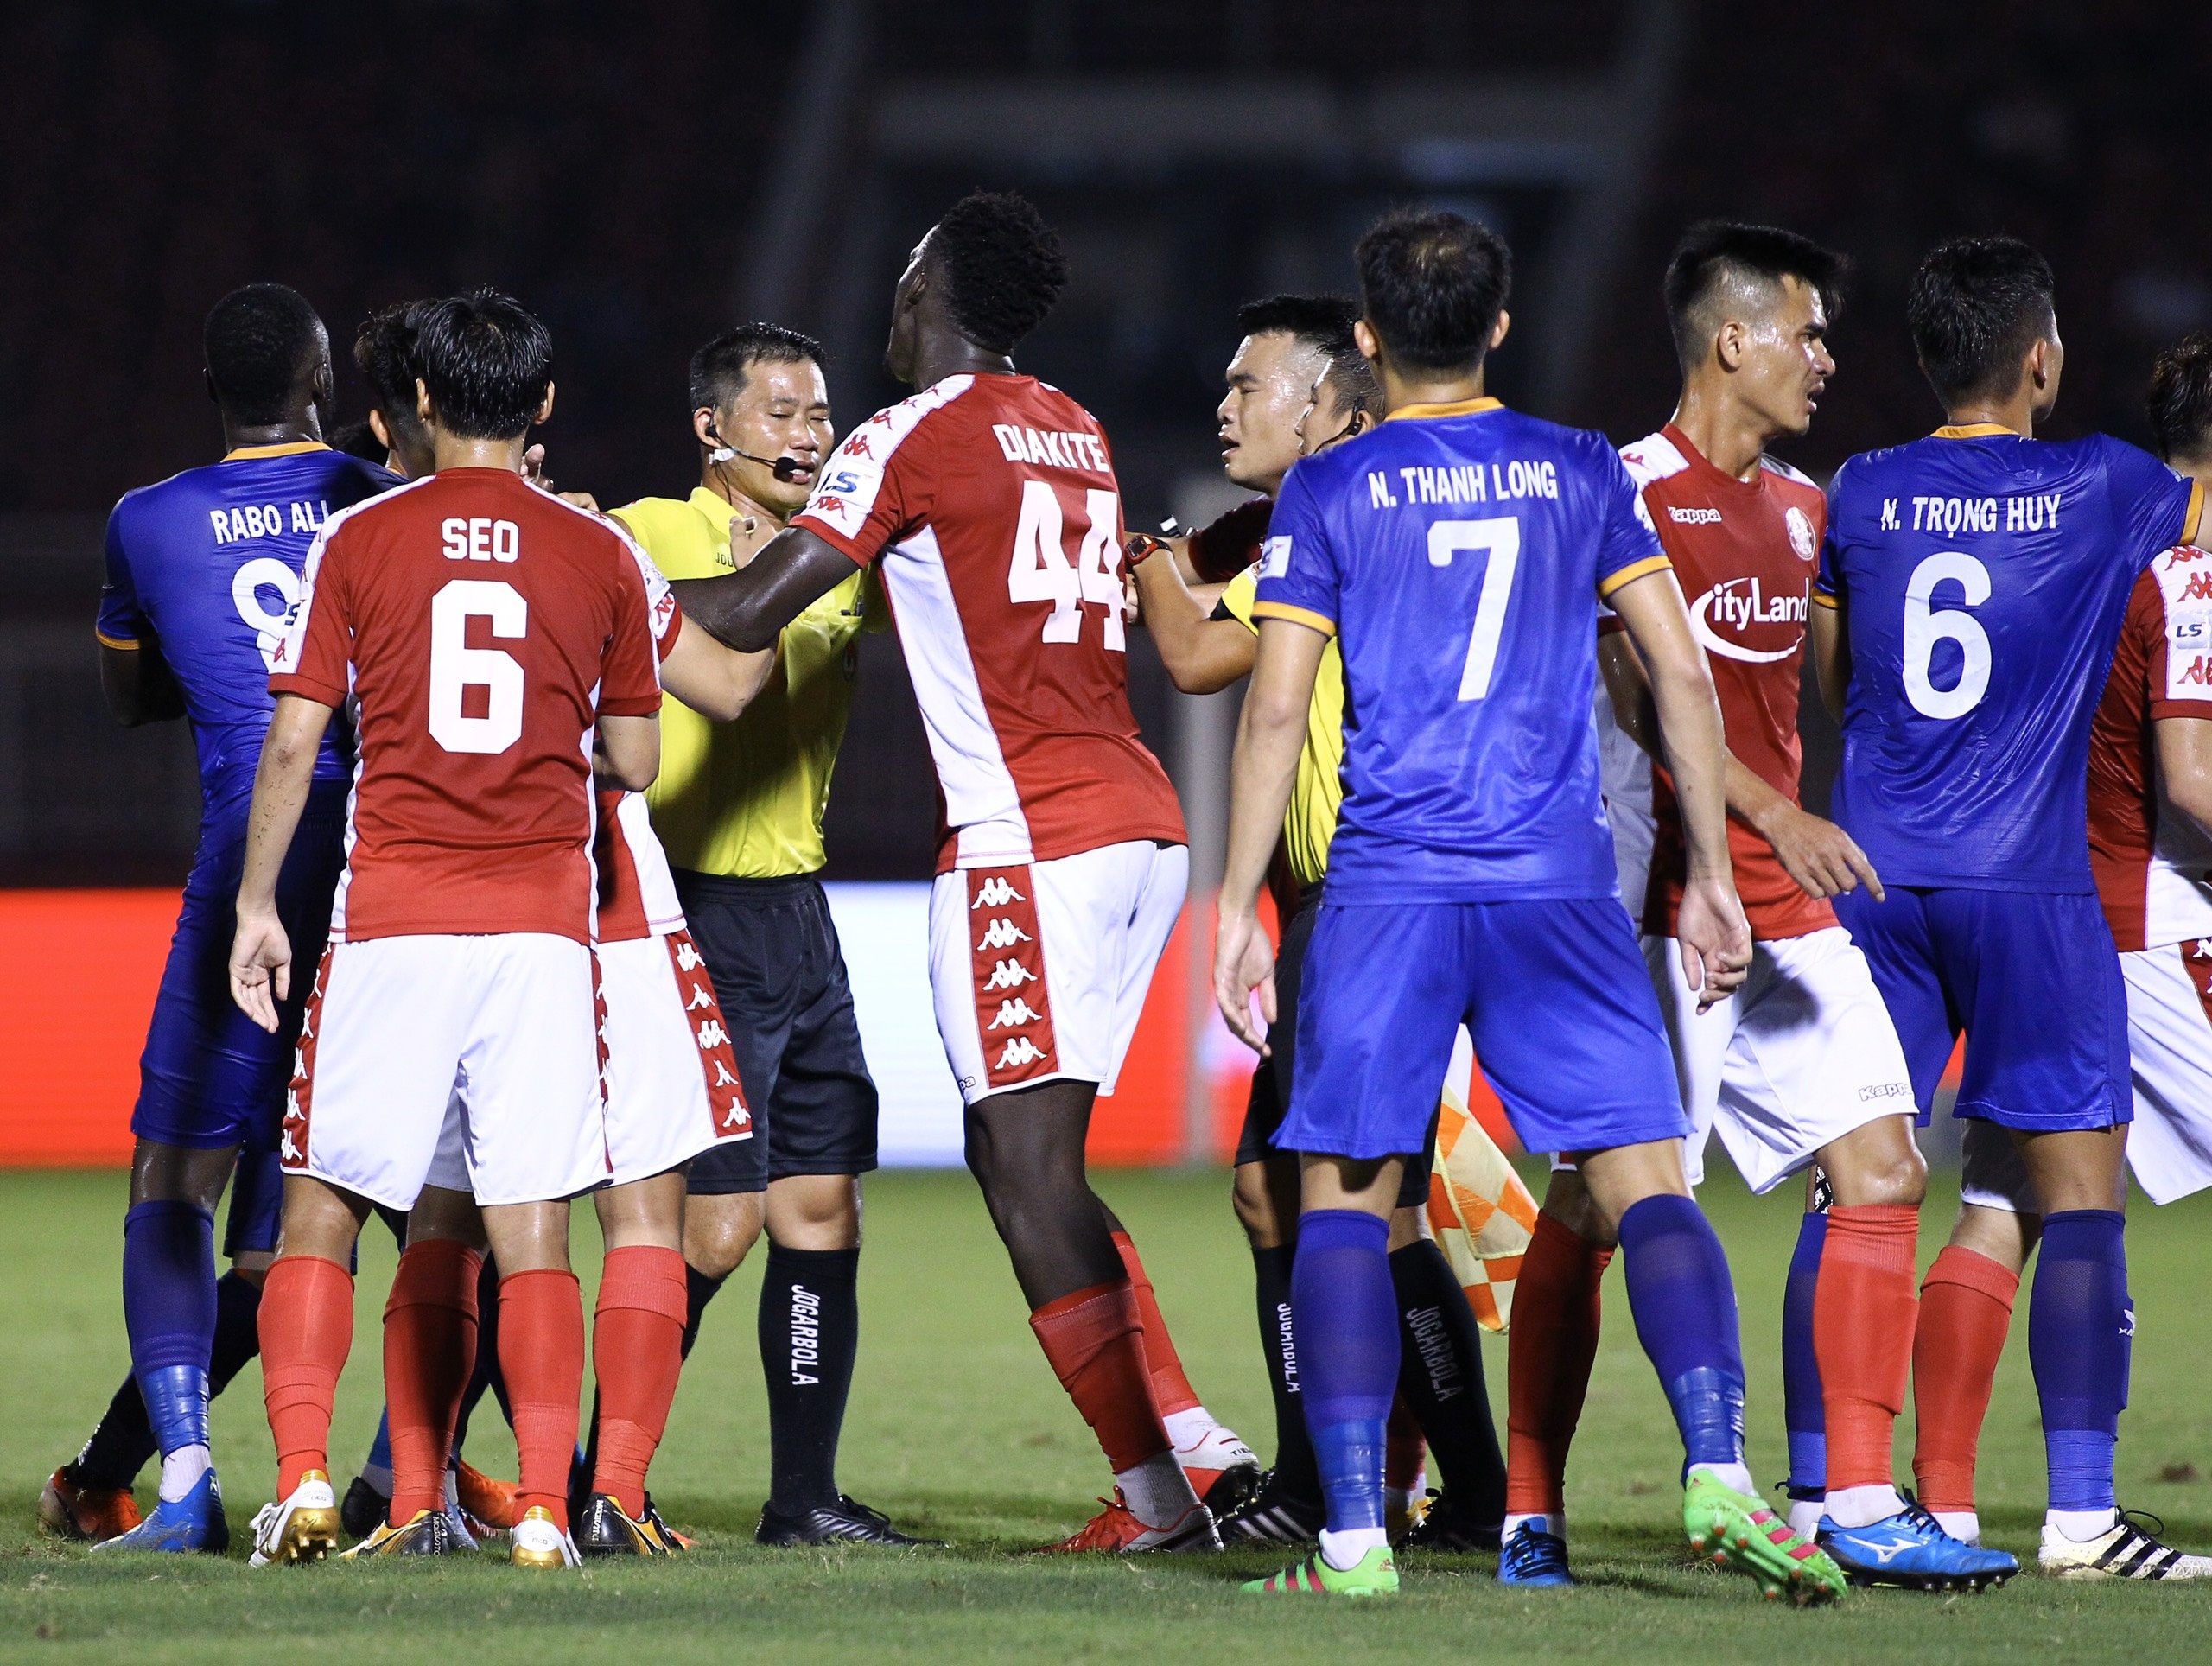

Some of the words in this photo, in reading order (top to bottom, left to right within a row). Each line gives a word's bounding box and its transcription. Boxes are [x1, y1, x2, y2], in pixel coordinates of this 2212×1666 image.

[992, 424, 1110, 473] DIAKITE
[1368, 471, 1397, 509] N.
[1400, 465, 1486, 504] THANH
[1492, 461, 1559, 500] LONG
[209, 504, 283, 544] RABO
[1881, 498, 1901, 531] N.
[1912, 496, 1998, 538] TRỌNG
[2006, 493, 2062, 531] HUY
[441, 518, 519, 563] SEO
[1007, 480, 1127, 652] 44
[1427, 516, 1521, 702] 7
[2176, 623, 2202, 638] LS
[1902, 551, 1993, 720] 6
[428, 579, 528, 755] 6
[1858, 1082, 1913, 1102] Kapp
[791, 1284, 821, 1385] JOGARBOLA
[1406, 1305, 1464, 1402] JOGARBOLA
